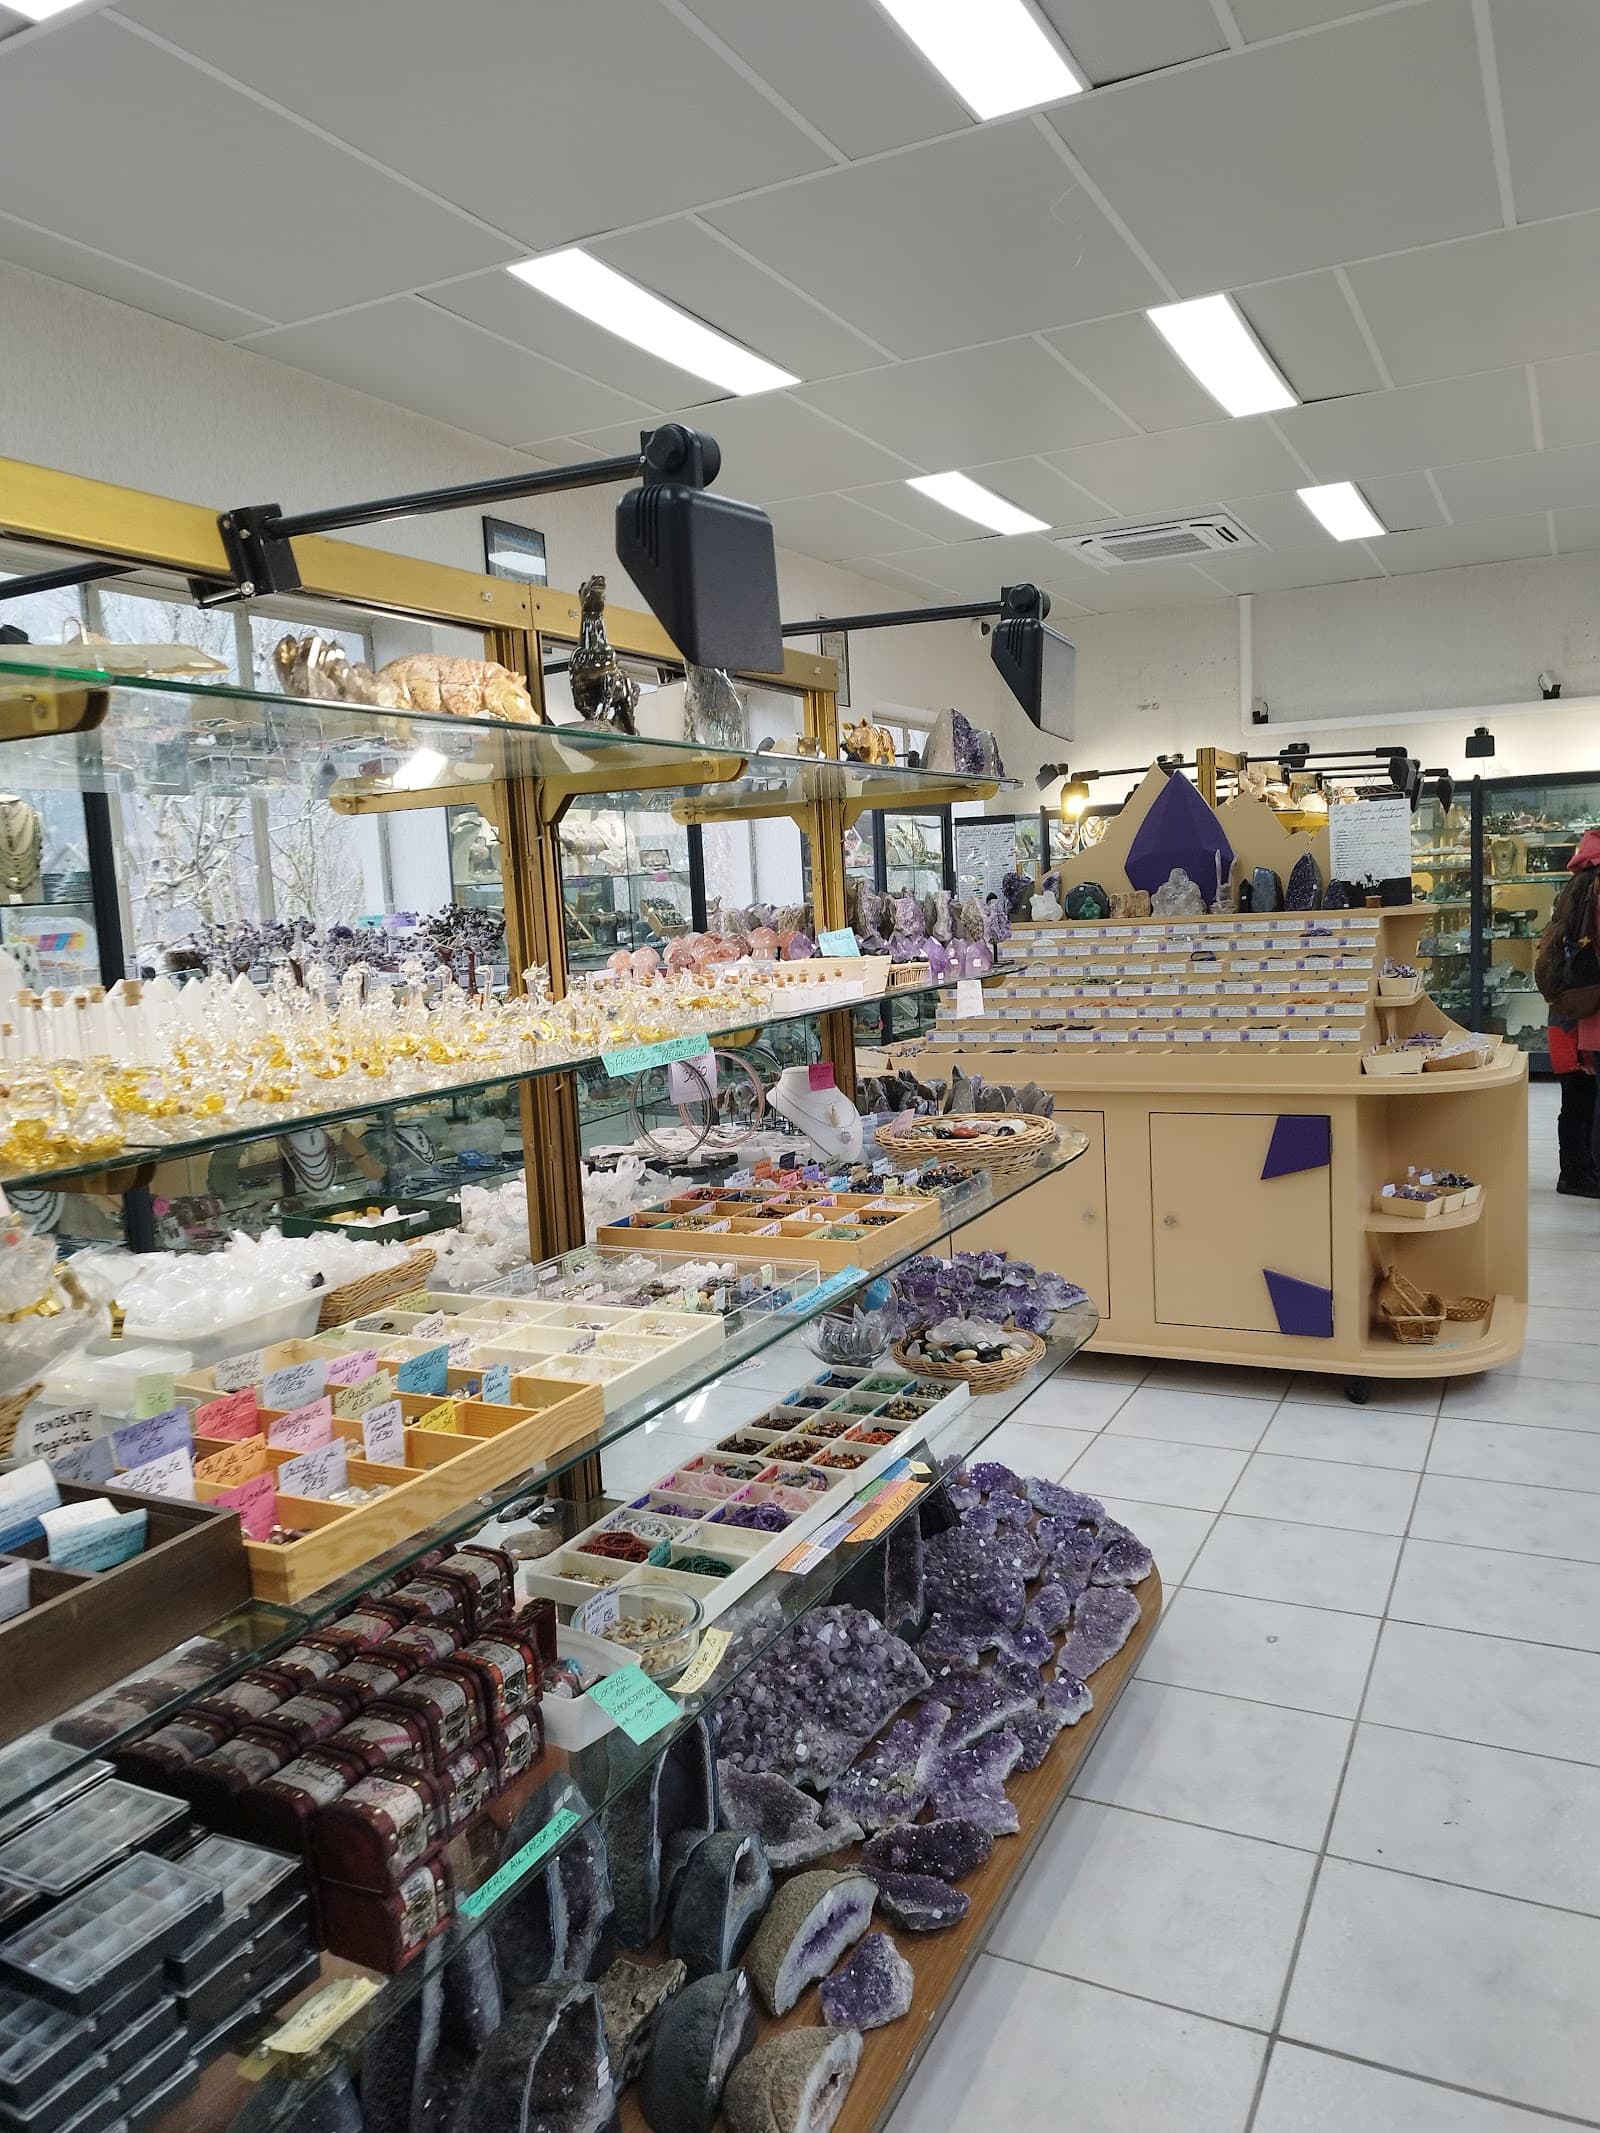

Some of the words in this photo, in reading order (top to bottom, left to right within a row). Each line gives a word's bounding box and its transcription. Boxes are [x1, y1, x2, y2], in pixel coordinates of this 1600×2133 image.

[34, 1409, 95, 1434] PENDENTIF
[593, 1673, 629, 1702] COFFRE
[468, 1869, 506, 1910] COFFRE
